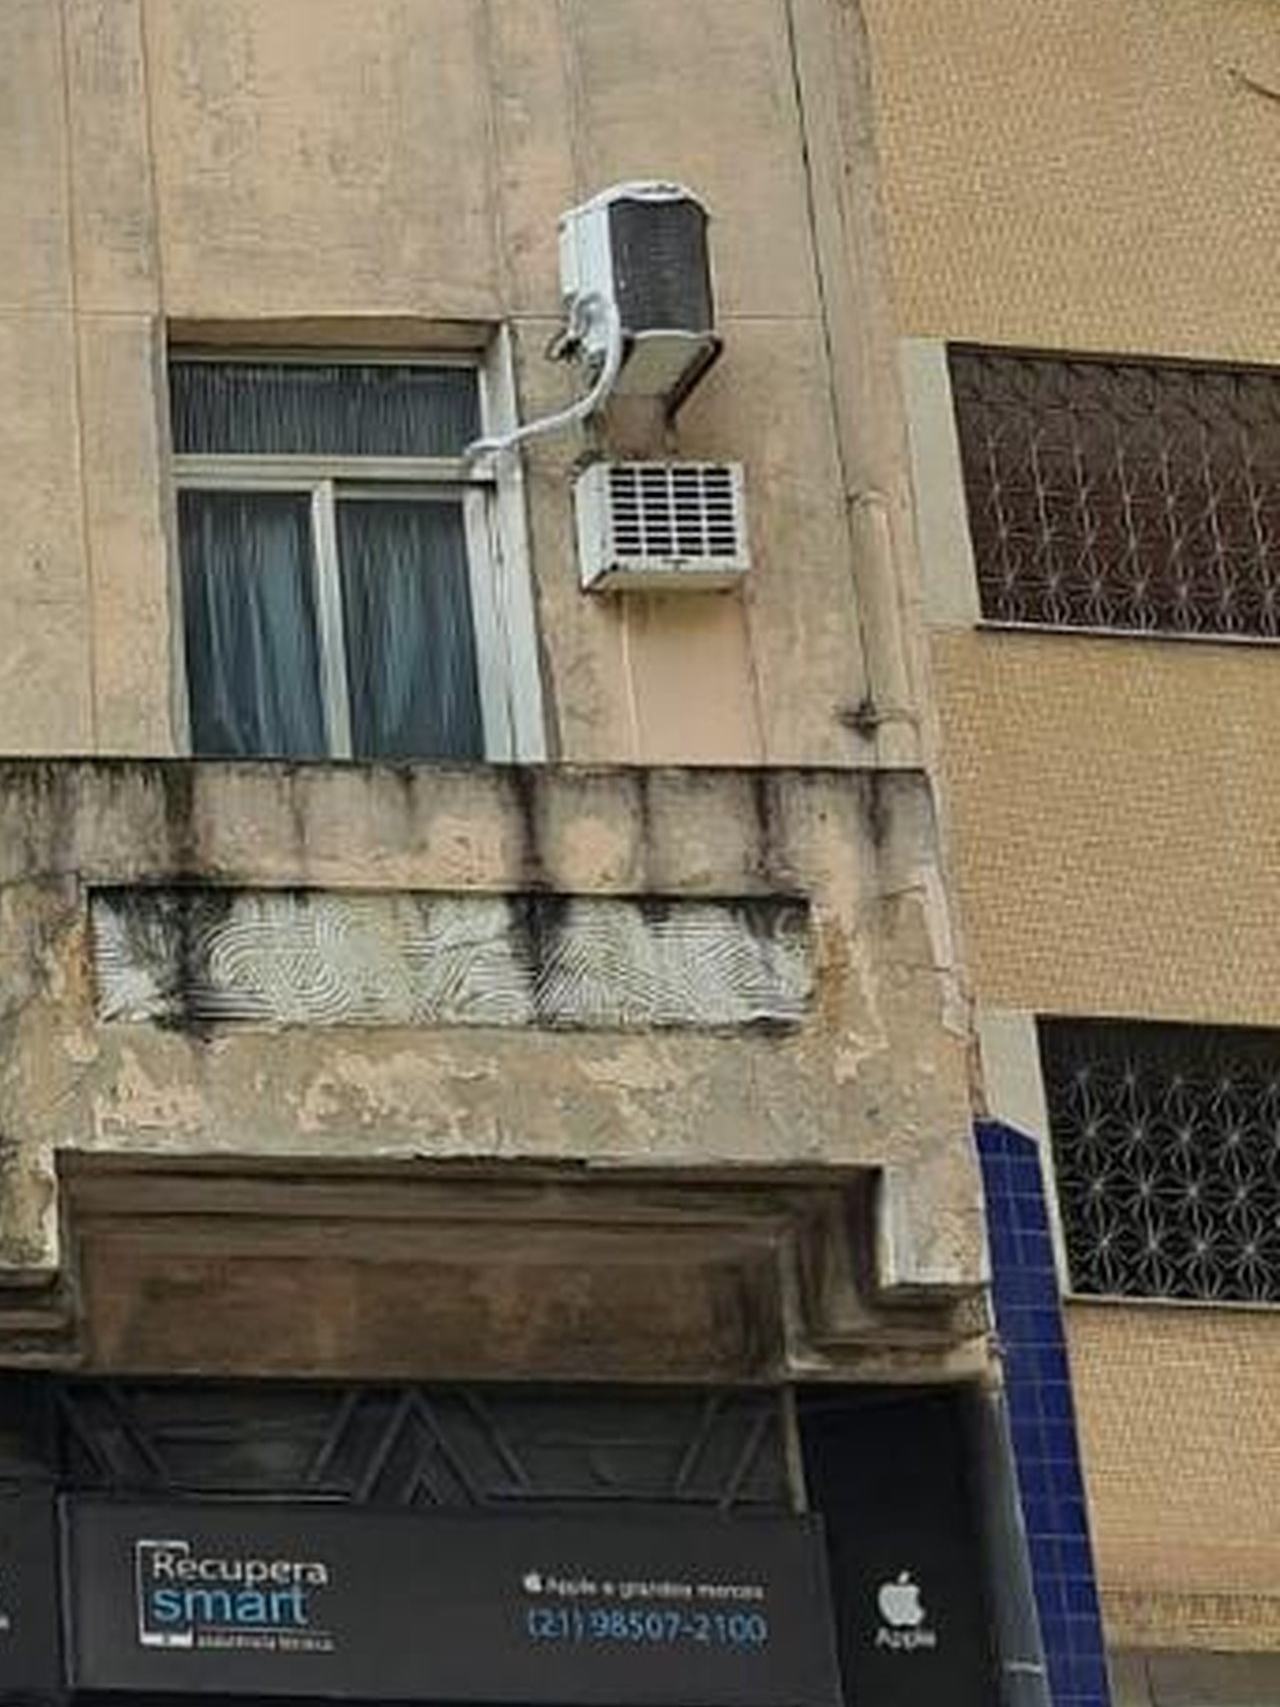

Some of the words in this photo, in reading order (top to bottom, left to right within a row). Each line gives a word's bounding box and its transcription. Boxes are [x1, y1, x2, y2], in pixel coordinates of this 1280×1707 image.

[152, 1550, 330, 1587] Recupera
[153, 1585, 308, 1624] smart
[527, 1607, 586, 1641] (21)
[591, 1608, 768, 1643] 98507-2100
